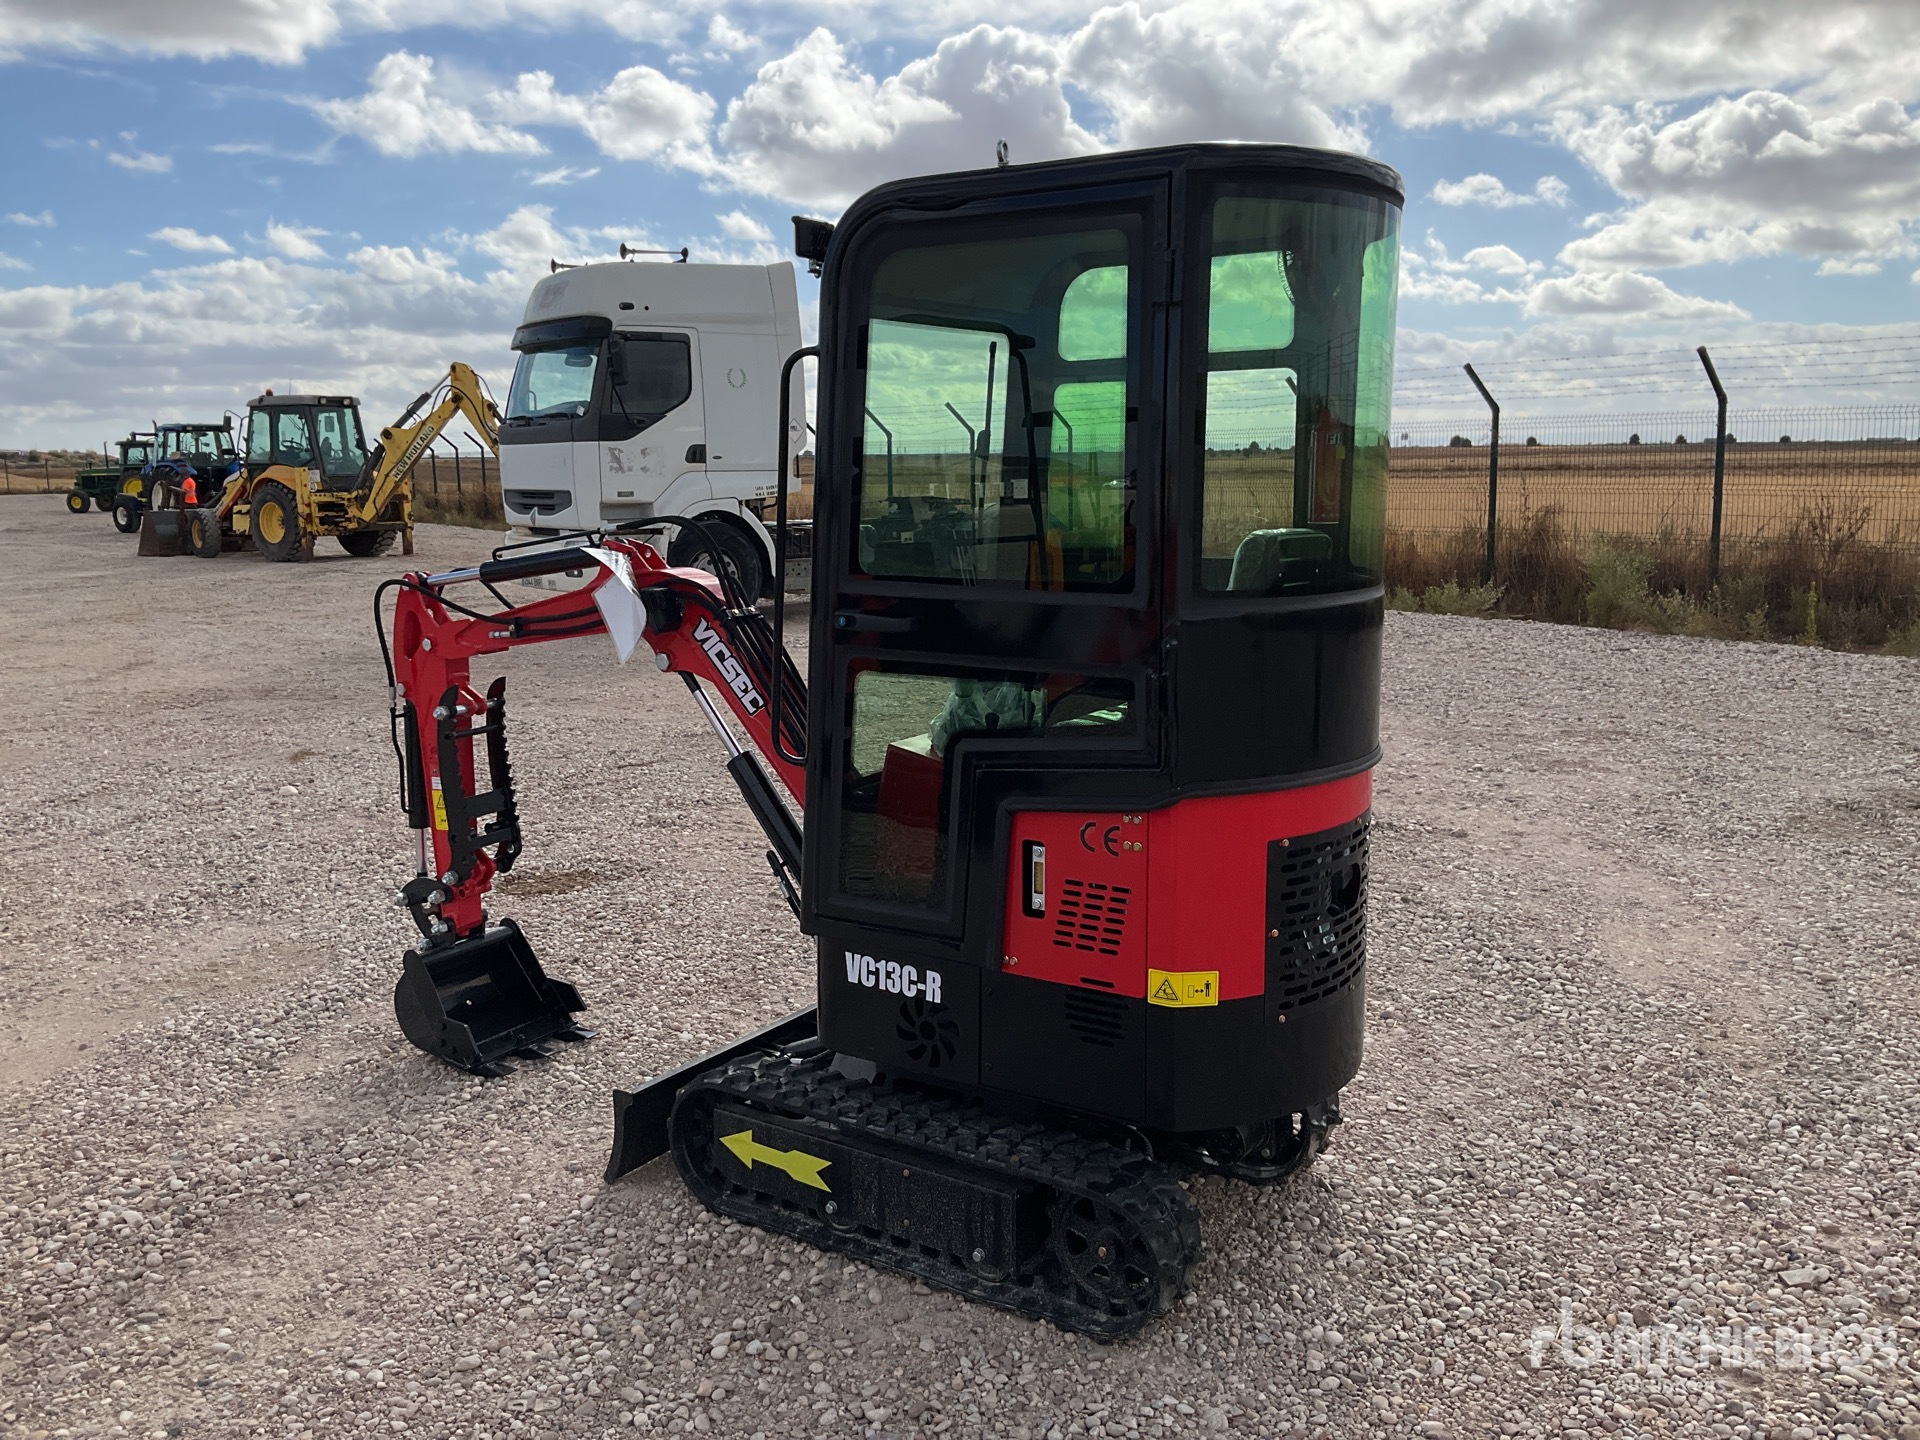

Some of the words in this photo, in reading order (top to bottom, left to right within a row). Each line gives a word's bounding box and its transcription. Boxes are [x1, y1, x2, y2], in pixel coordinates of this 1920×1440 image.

[393, 458, 409, 479] NEW
[405, 425, 435, 461] HOLLAND
[693, 617, 765, 716] VICSEC
[1080, 822, 1121, 857] CE
[845, 951, 942, 1004] VC13C-R
